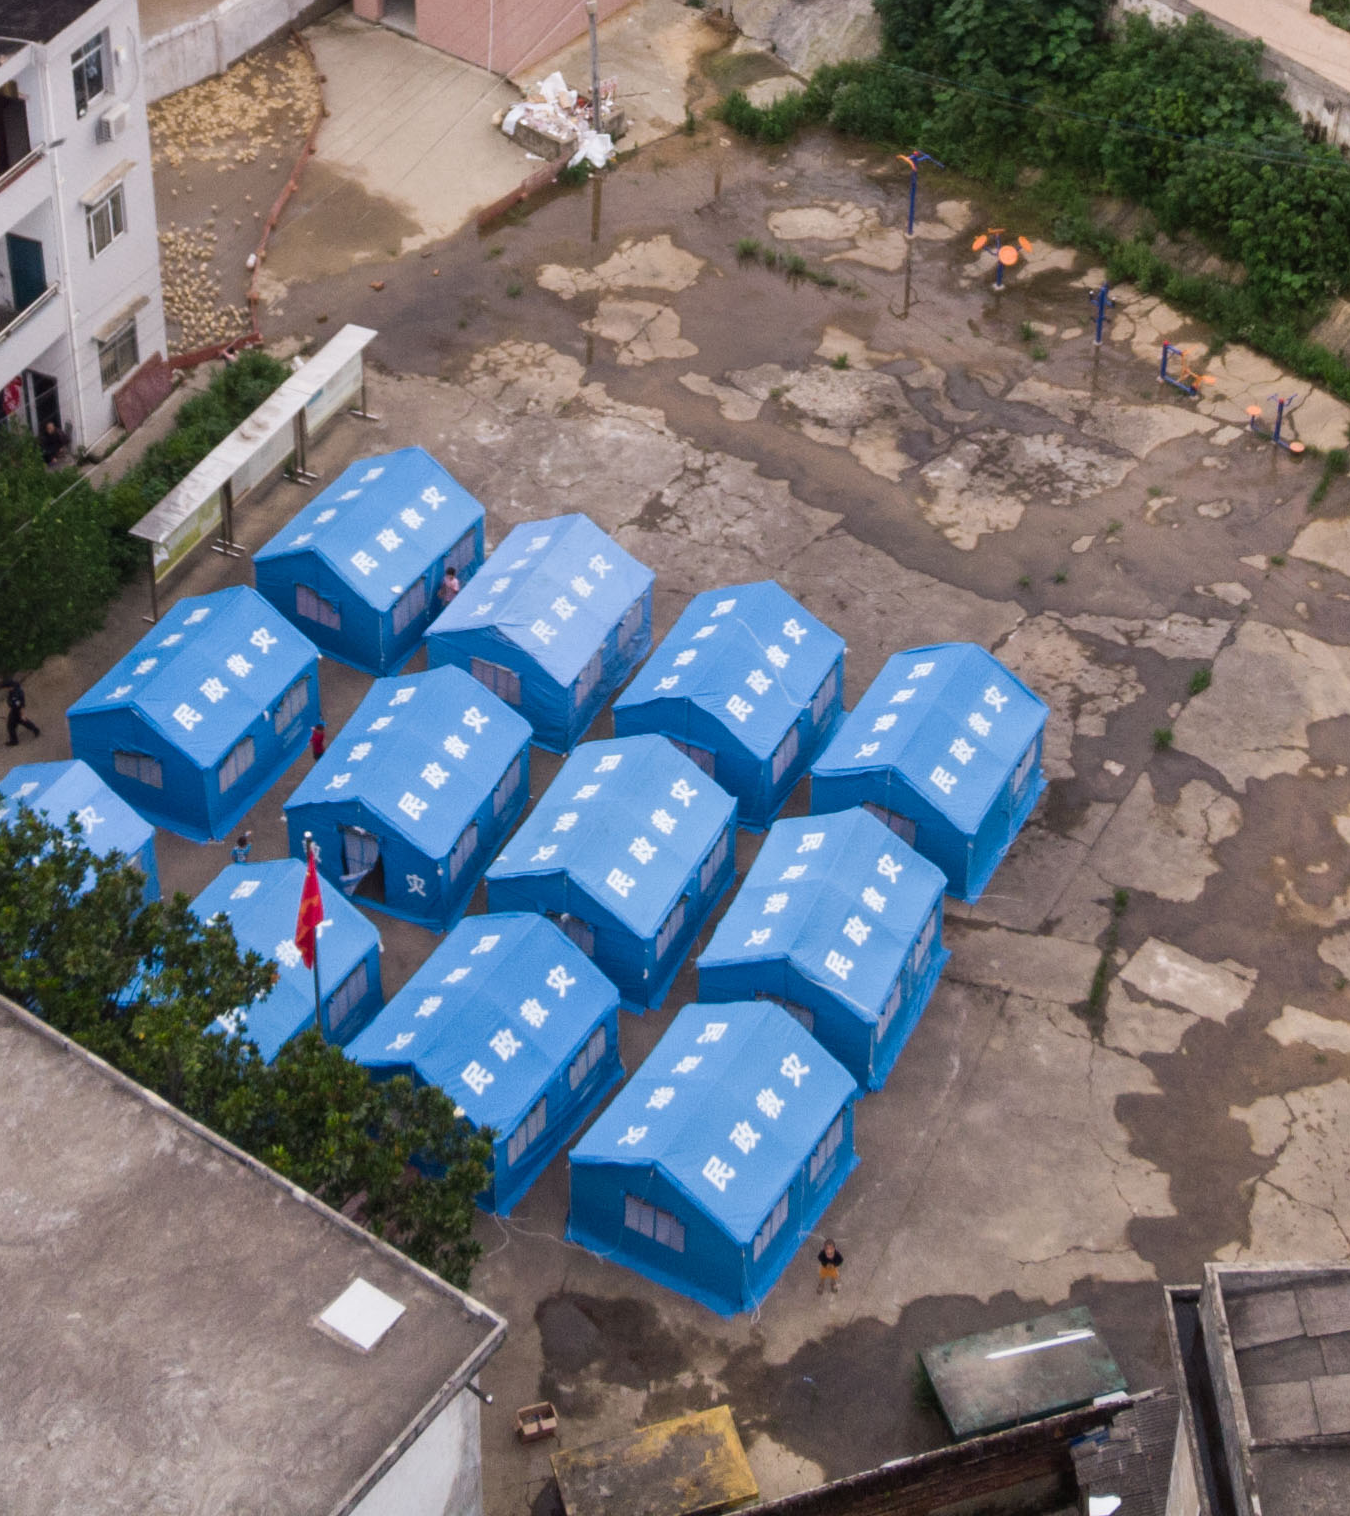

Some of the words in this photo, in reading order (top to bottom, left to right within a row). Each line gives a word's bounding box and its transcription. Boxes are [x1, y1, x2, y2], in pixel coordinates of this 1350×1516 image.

[350, 486, 447, 576] 民政救灾
[530, 553, 613, 645] 民政救灾
[172, 627, 277, 731] 民政救灾
[726, 618, 807, 722] 民政救灾
[397, 706, 489, 821] 民政救灾
[930, 685, 1008, 794] 民政救灾
[606, 778, 698, 898] 民政救灾
[824, 854, 903, 981] 民政救灾
[461, 965, 576, 1095] 民政救灾
[702, 1053, 810, 1192] 民政救灾
